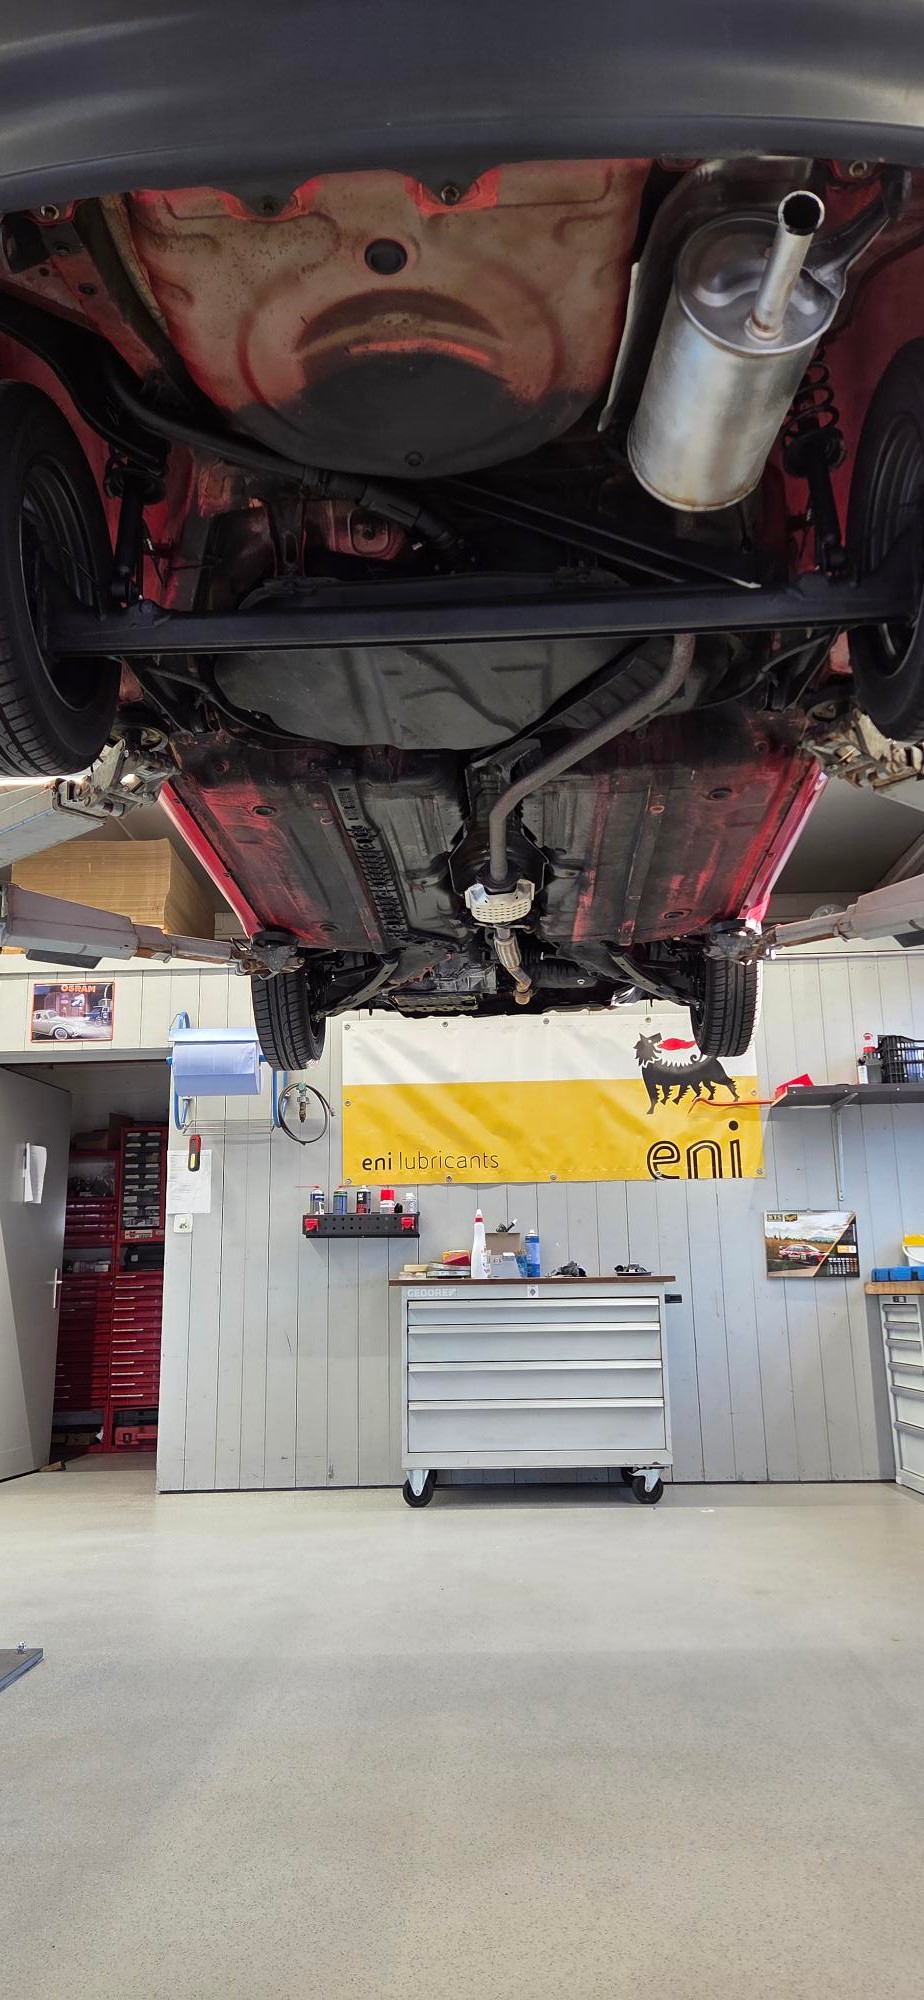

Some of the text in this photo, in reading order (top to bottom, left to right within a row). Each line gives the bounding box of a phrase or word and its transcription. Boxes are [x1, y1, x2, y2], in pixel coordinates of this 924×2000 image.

[61, 984, 96, 993] OSRAM
[362, 1150, 499, 1171] eni lubricants
[646, 1120, 743, 1180] eni
